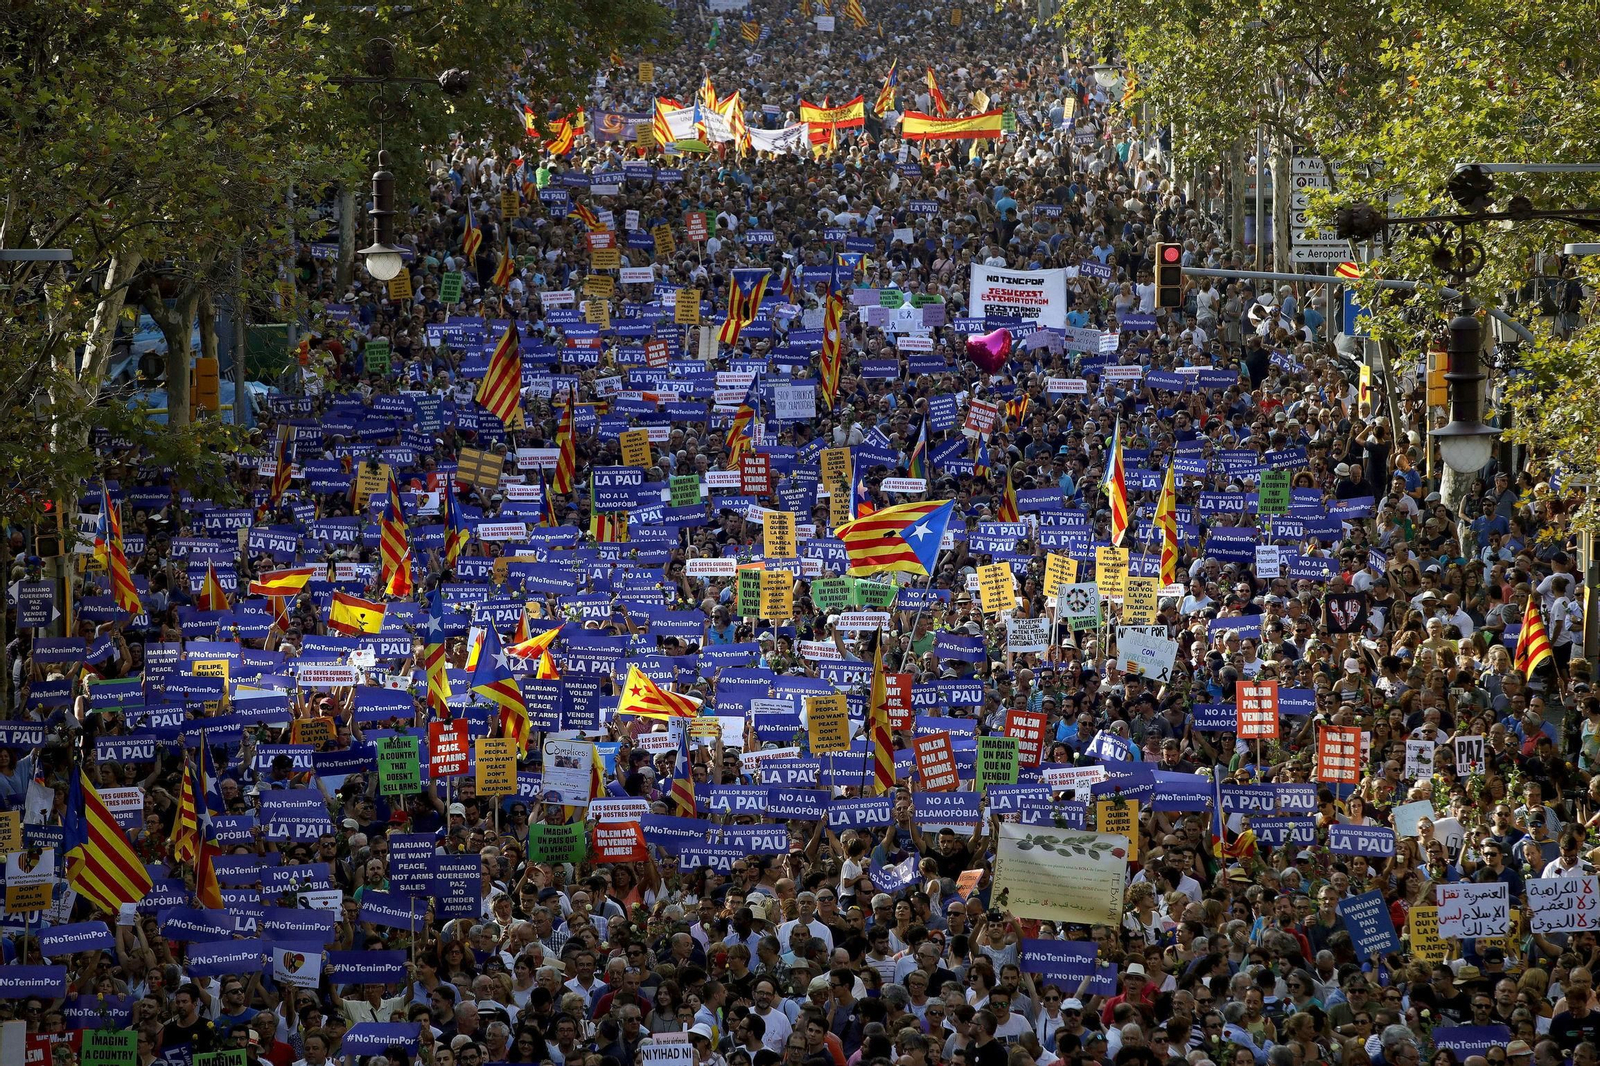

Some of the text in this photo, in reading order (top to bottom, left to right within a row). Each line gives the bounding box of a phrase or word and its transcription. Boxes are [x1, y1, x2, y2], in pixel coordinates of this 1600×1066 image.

[1309, 160, 1322, 169] Av.
[1308, 178, 1319, 186] Pl.
[910, 204, 938, 212] LA PAU
[1308, 250, 1346, 259] Aeroport
[1081, 266, 1111, 279] LA PAU
[1000, 277, 1025, 285] TINC
[595, 475, 641, 485] LA PAU
[1200, 500, 1243, 509] LA PAU
[1330, 505, 1371, 513] #NoTenimPor
[206, 518, 251, 528] LA PAU
[666, 514, 705, 522] #NoTenimPor
[314, 530, 359, 542] LA PAU
[1212, 535, 1256, 543] #NoTenimPor
[970, 541, 1015, 551] LA PAU
[528, 576, 574, 588] #NoTenimPor
[987, 602, 1011, 610] WEAPONS
[652, 620, 700, 628] #NoTenimPor
[36, 647, 83, 655] #NoTenimPor
[938, 643, 983, 654] #NoTenimPor
[188, 651, 239, 659] #NoTenimPor
[720, 677, 771, 686] #NoTenimPor
[165, 686, 220, 694] #NoTenimPor
[1243, 687, 1271, 696] VOLEM
[952, 691, 982, 702] PAU
[357, 703, 411, 712] #NoTenimPor
[1013, 716, 1040, 727] VOLEM
[1242, 712, 1273, 721] VENDRE
[1242, 725, 1274, 734] ARMES!
[12, 732, 43, 744] PAU
[439, 733, 458, 742] WANT
[1326, 733, 1354, 742] VOLEM
[383, 740, 411, 749] IMAGINE
[919, 739, 945, 752] VOLEM
[97, 746, 154, 761] LA PAU
[1458, 741, 1483, 763] PAZ
[316, 756, 373, 768] #NoTenimPor
[923, 765, 952, 777] VENDRE
[386, 772, 412, 781] DOESN'T
[926, 777, 955, 790] ARMES!
[710, 797, 730, 809] LA
[1281, 795, 1314, 808] PAU
[829, 808, 890, 825] LA PAU
[26, 832, 64, 840] MARIANO
[644, 826, 703, 838] #NoTenimPor
[392, 841, 433, 849] MARIANO,
[752, 837, 786, 850] PAU
[1331, 837, 1393, 853] LA PAU
[604, 847, 632, 855] ARMES!
[399, 863, 427, 871] PEACE,
[1531, 879, 1593, 901] لا للكراهية
[1438, 886, 1506, 907] العنصرية تقتل
[1344, 899, 1381, 914] MARIANO
[1351, 908, 1379, 921] VOLEM
[166, 918, 230, 936] #NoTenimPor
[264, 921, 331, 932] #NoTenimPor
[43, 930, 107, 945] #NoTenimPor
[1358, 932, 1390, 946] VENDRE
[1364, 941, 1391, 954] ARMES
[191, 952, 259, 965] #NoTenimPor
[1025, 952, 1093, 964] #NoTenimPor
[334, 963, 402, 972] #NoTenimPor
[347, 1034, 416, 1045] #NoTenimPor
[85, 1050, 134, 1060] A COUNTRY
[643, 1048, 691, 1060] NI YIHAD NI
